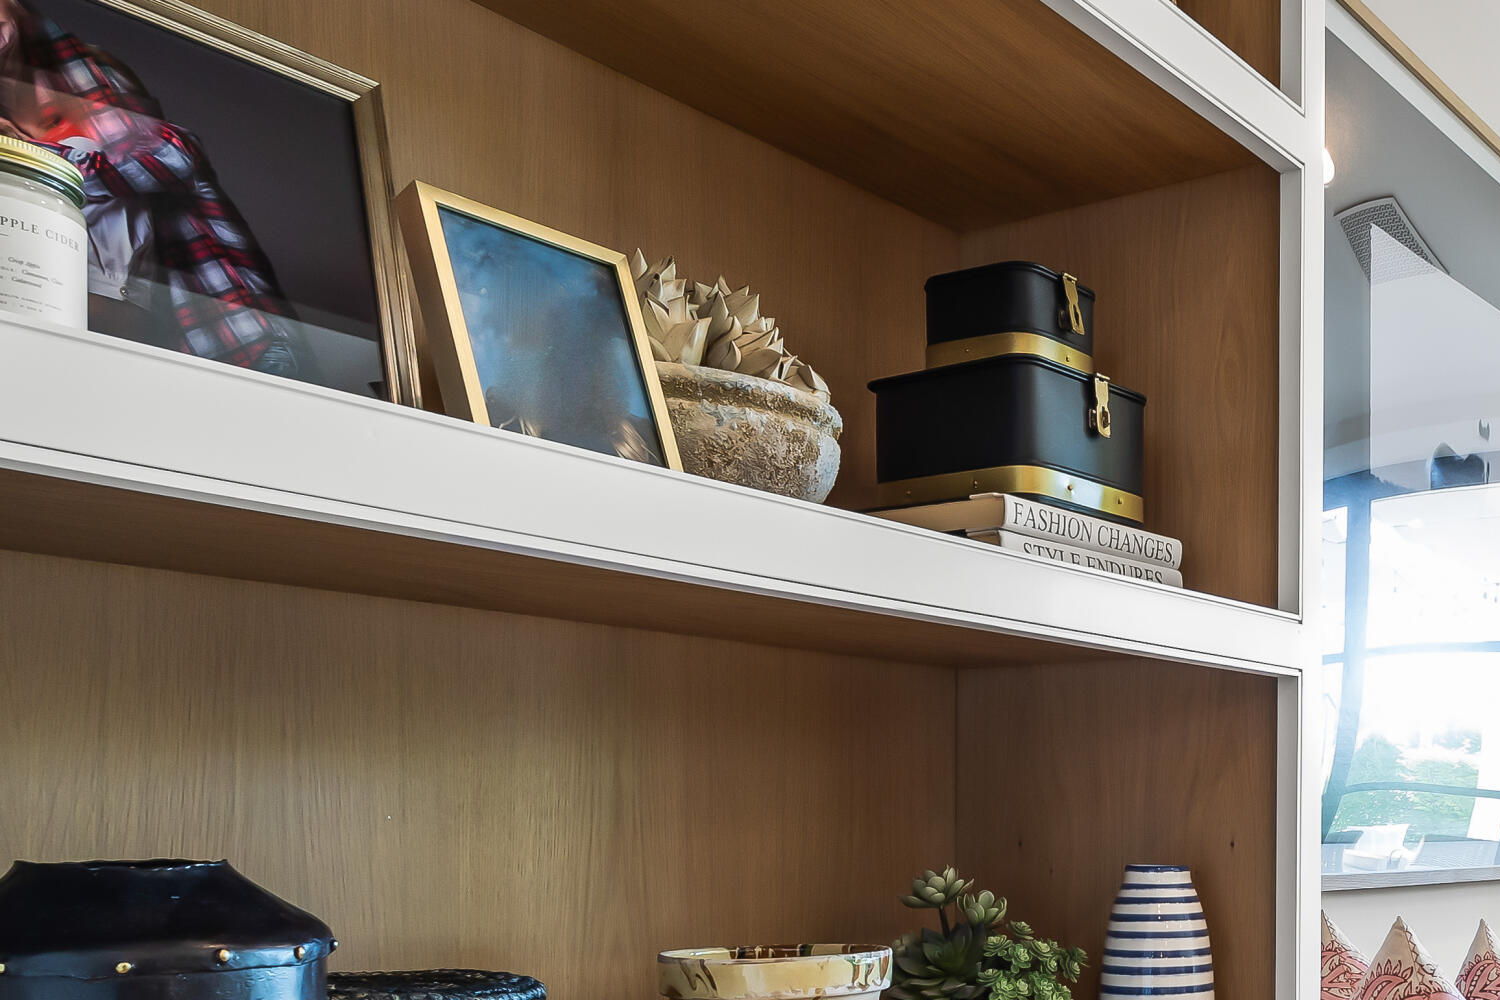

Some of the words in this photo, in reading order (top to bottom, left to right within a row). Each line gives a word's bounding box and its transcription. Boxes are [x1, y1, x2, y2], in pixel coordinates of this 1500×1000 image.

[45, 229, 79, 252] CIDER
[1013, 502, 1093, 542] FASHION
[1097, 525, 1175, 567] CHANGES,
